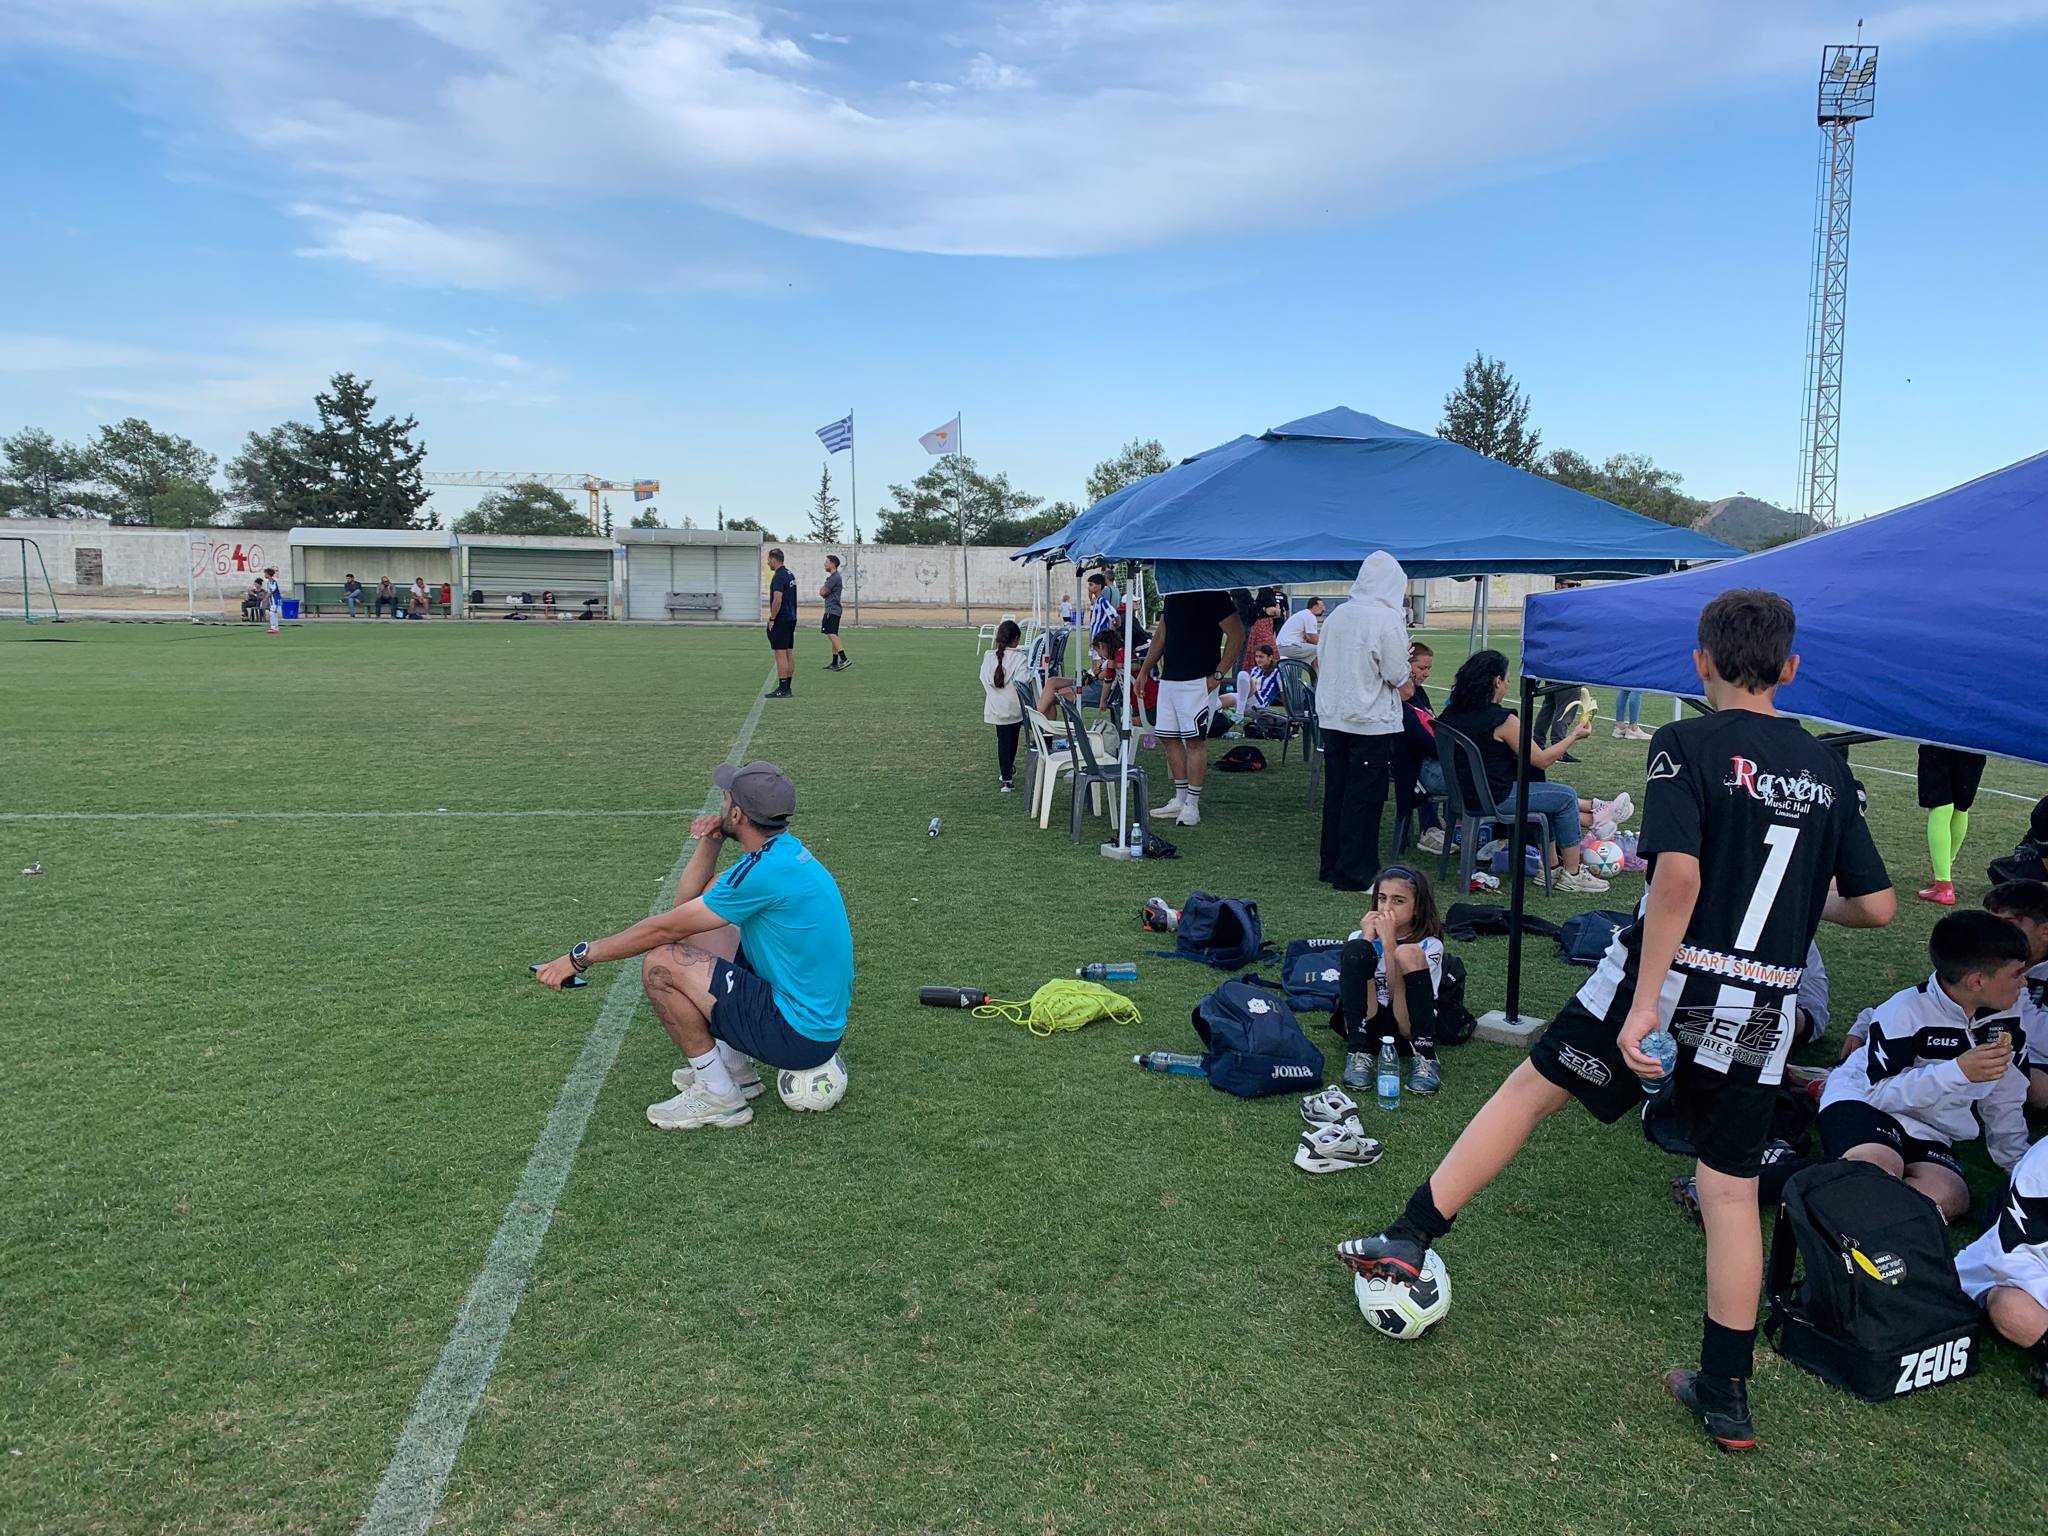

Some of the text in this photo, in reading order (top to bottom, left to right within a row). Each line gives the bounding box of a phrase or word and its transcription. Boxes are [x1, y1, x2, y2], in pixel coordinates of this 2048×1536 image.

[1726, 755, 1836, 809] Ravens
[1733, 823, 1800, 952] 1
[1676, 947, 1729, 970] SMART
[1679, 1031, 1775, 1068] PRIVATE SECURITY
[1880, 1266, 1904, 1279] CADEMY
[1893, 1336, 1971, 1394] ZEUS
